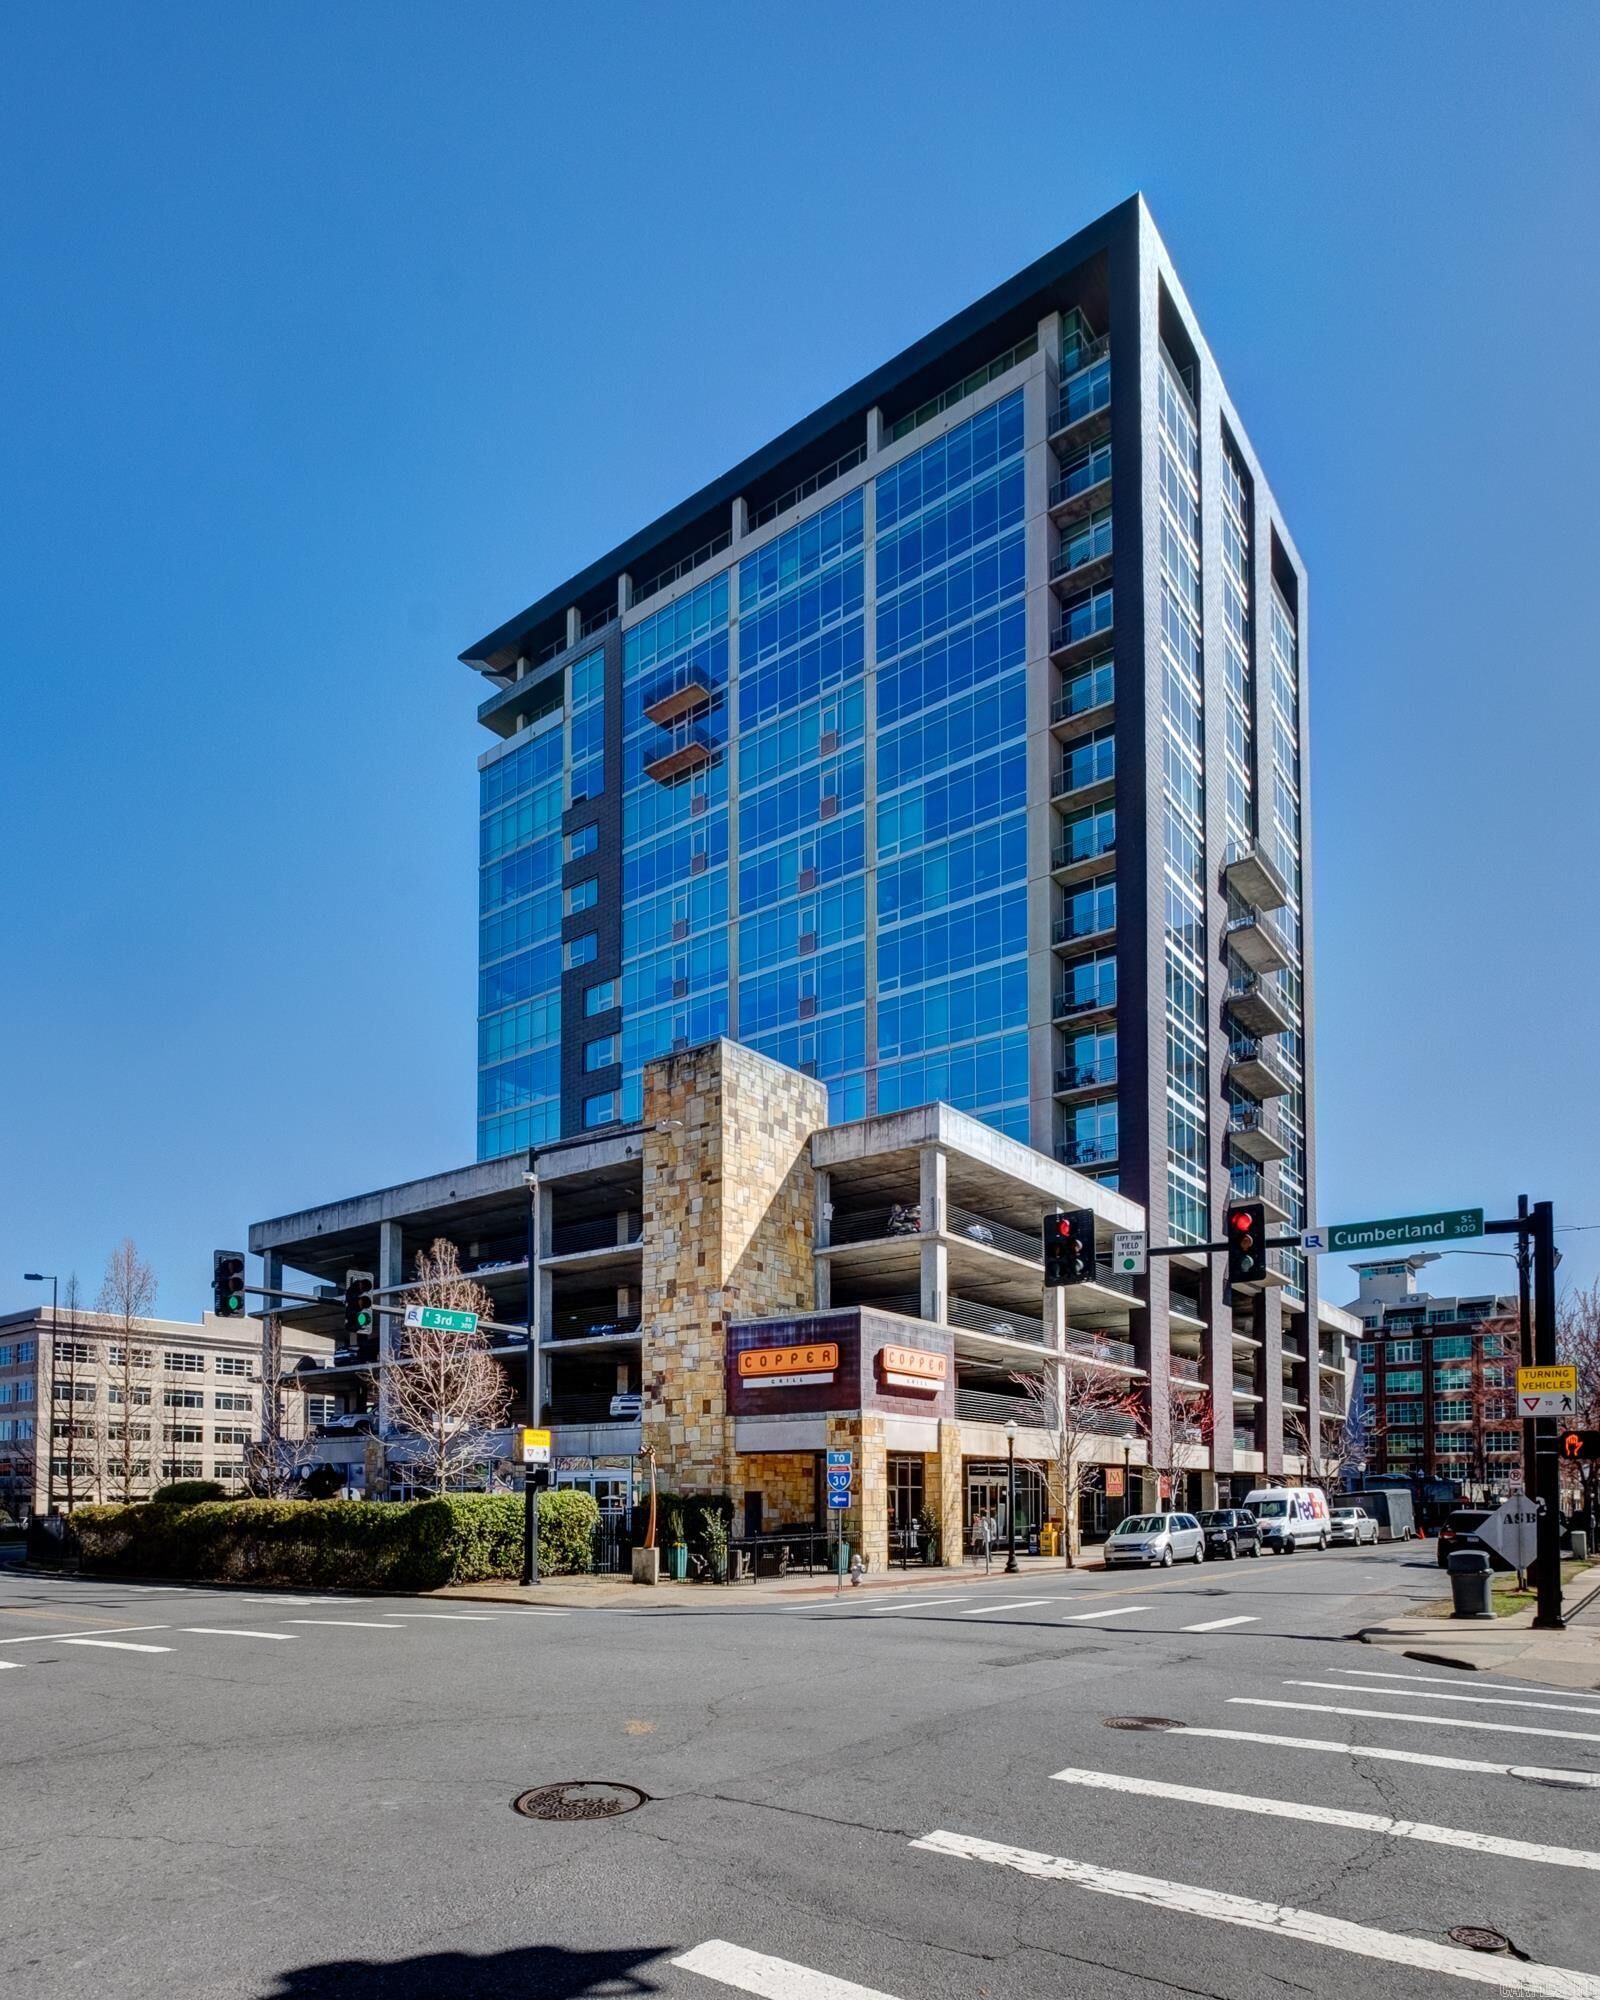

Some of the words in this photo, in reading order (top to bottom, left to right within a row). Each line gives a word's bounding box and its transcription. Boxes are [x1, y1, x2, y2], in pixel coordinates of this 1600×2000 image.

[1335, 1220, 1444, 1245] Cumberland
[1454, 1223, 1476, 1234] 300
[434, 1314, 453, 1326] 3rd
[745, 1350, 830, 1368] COPPER
[889, 1351, 943, 1371] COPPER
[1524, 1370, 1569, 1379] TURNING
[1522, 1381, 1572, 1390] VEHICLES
[833, 1454, 845, 1462] TO
[832, 1475, 847, 1486] 30
[1294, 1492, 1325, 1520] FedEx
[1504, 1513, 1537, 1525] ASB
